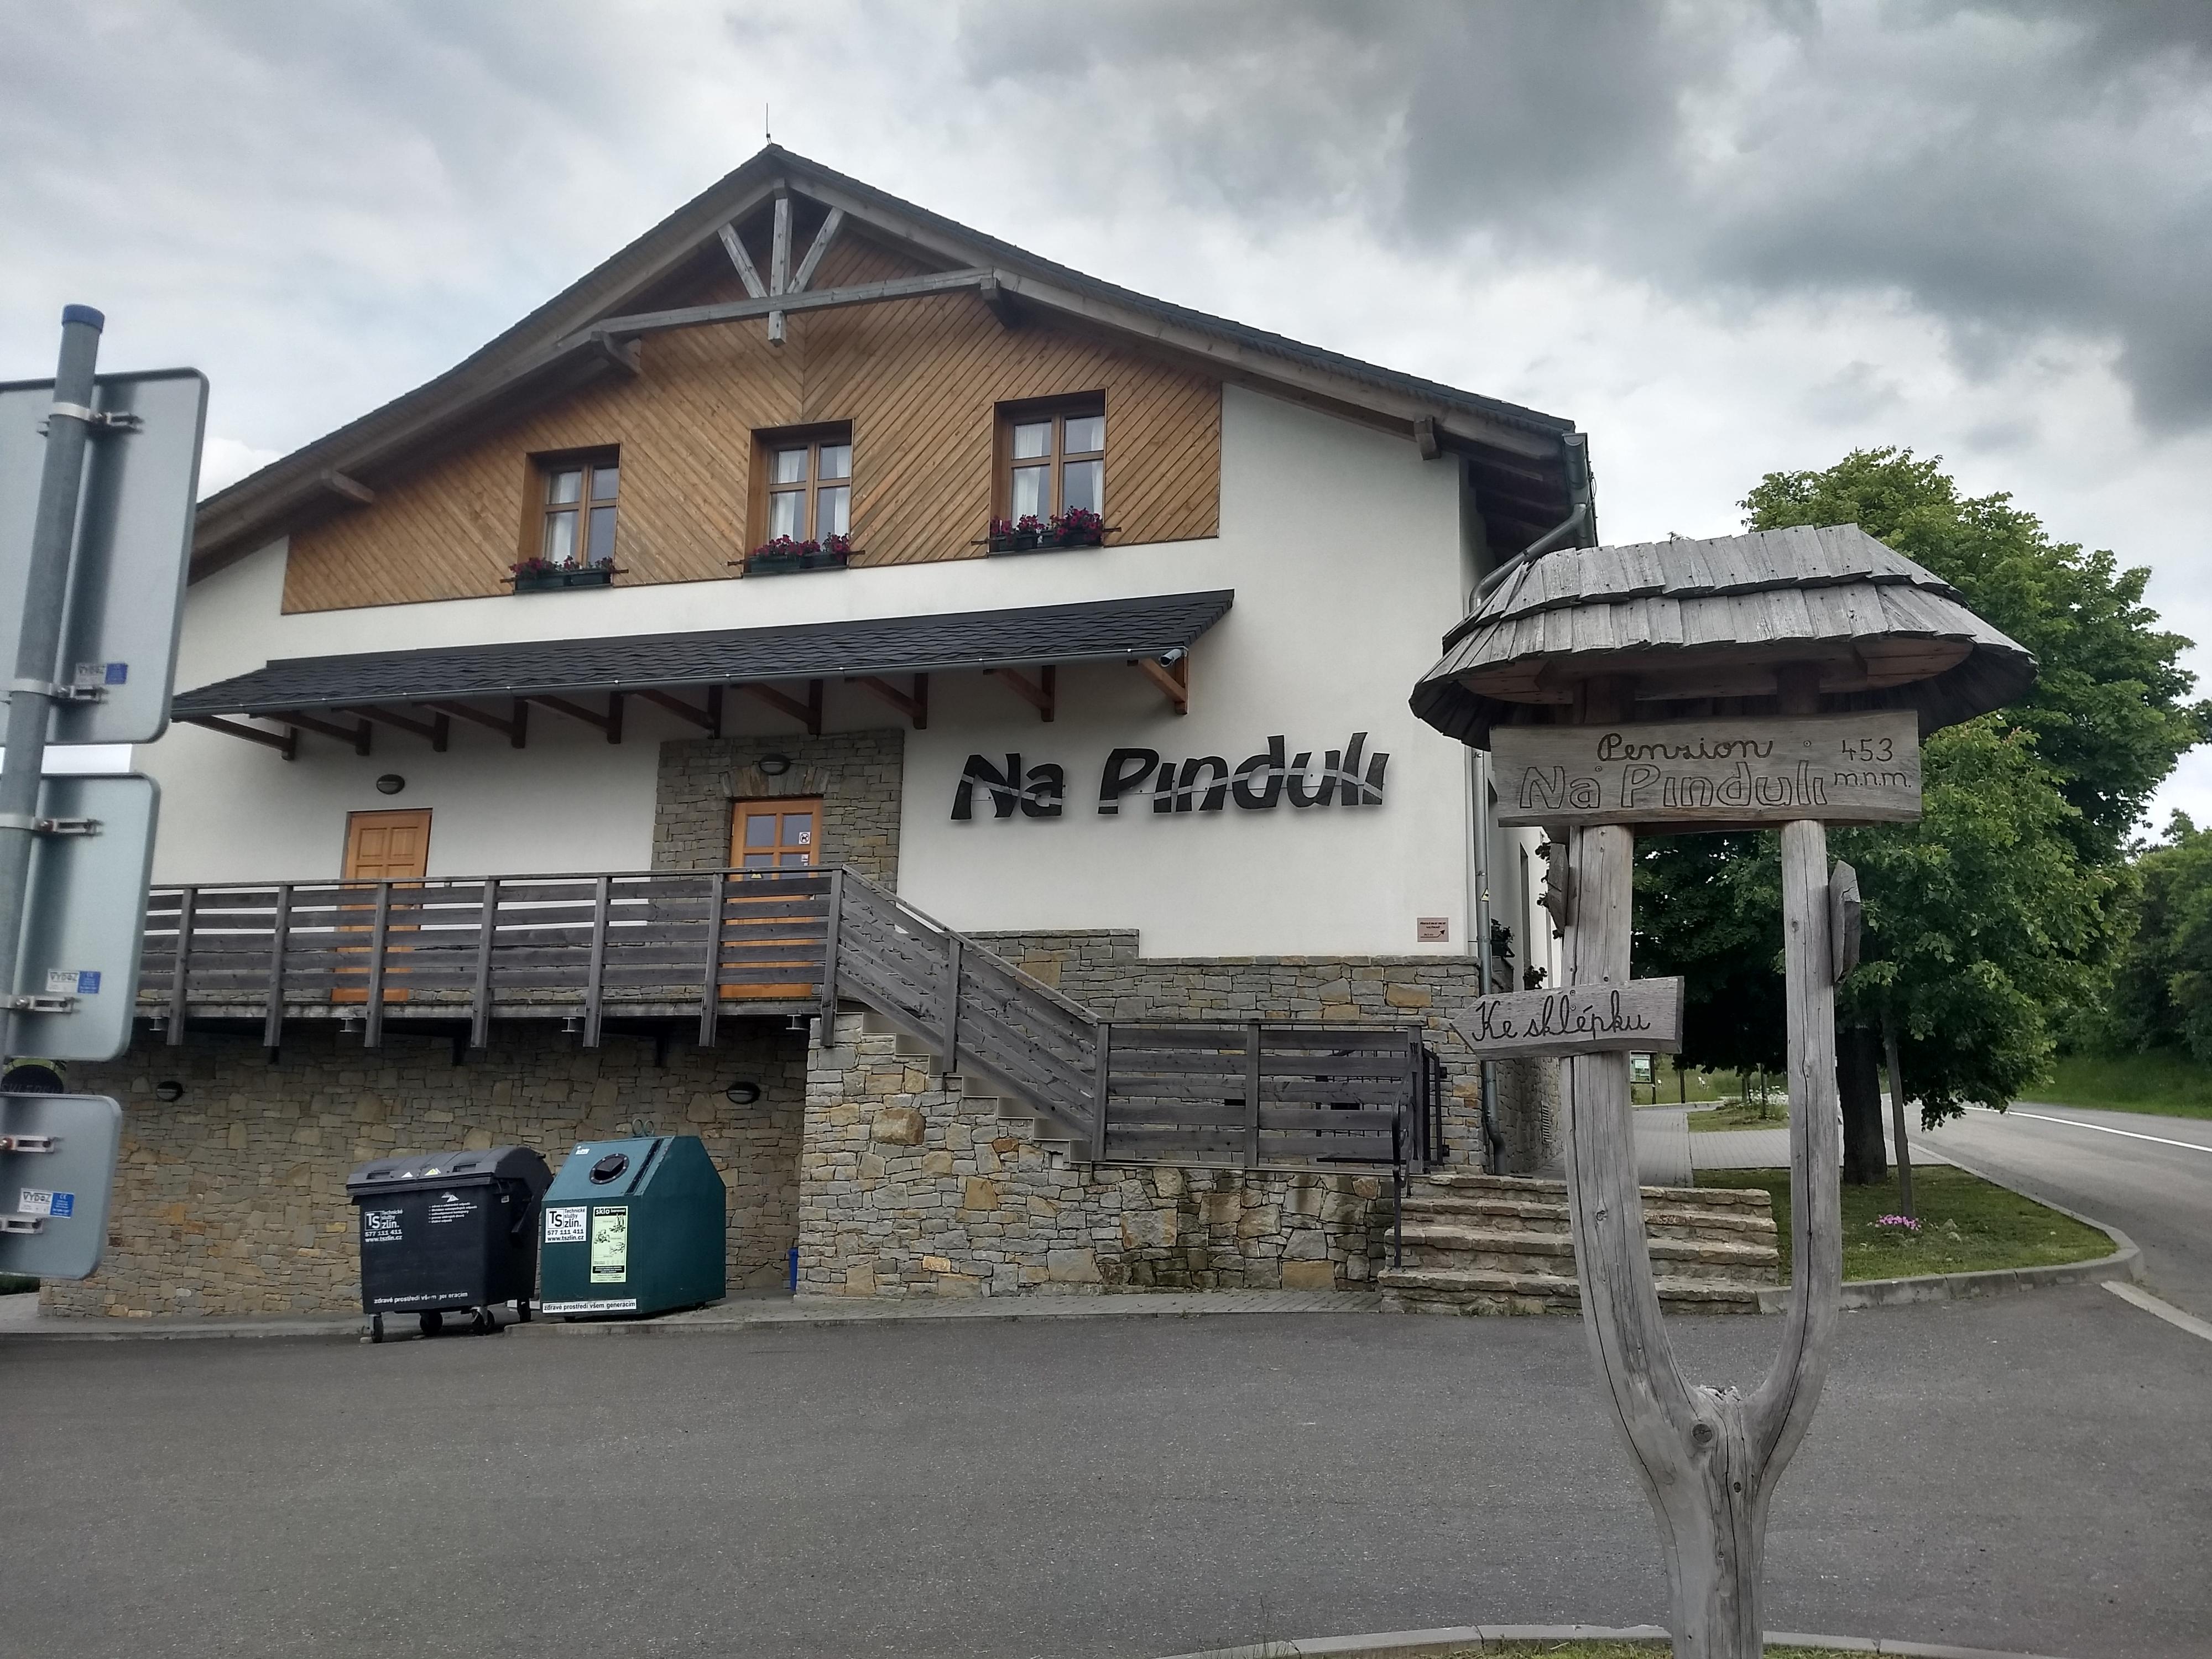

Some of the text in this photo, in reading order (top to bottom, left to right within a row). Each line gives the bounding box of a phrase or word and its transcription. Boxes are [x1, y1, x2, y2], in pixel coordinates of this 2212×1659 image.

[1597, 733, 1773, 761] Pension
[1841, 738, 1893, 762] 453
[951, 732, 1390, 820] Na Pinduli
[1520, 760, 1828, 809] Na Pinduli
[1834, 771, 1912, 788] m.n.m.
[1472, 990, 1651, 1041] Ke sklépku
[366, 1213, 380, 1229] TS
[549, 1211, 562, 1227] TS
[564, 1218, 581, 1228] zlín.
